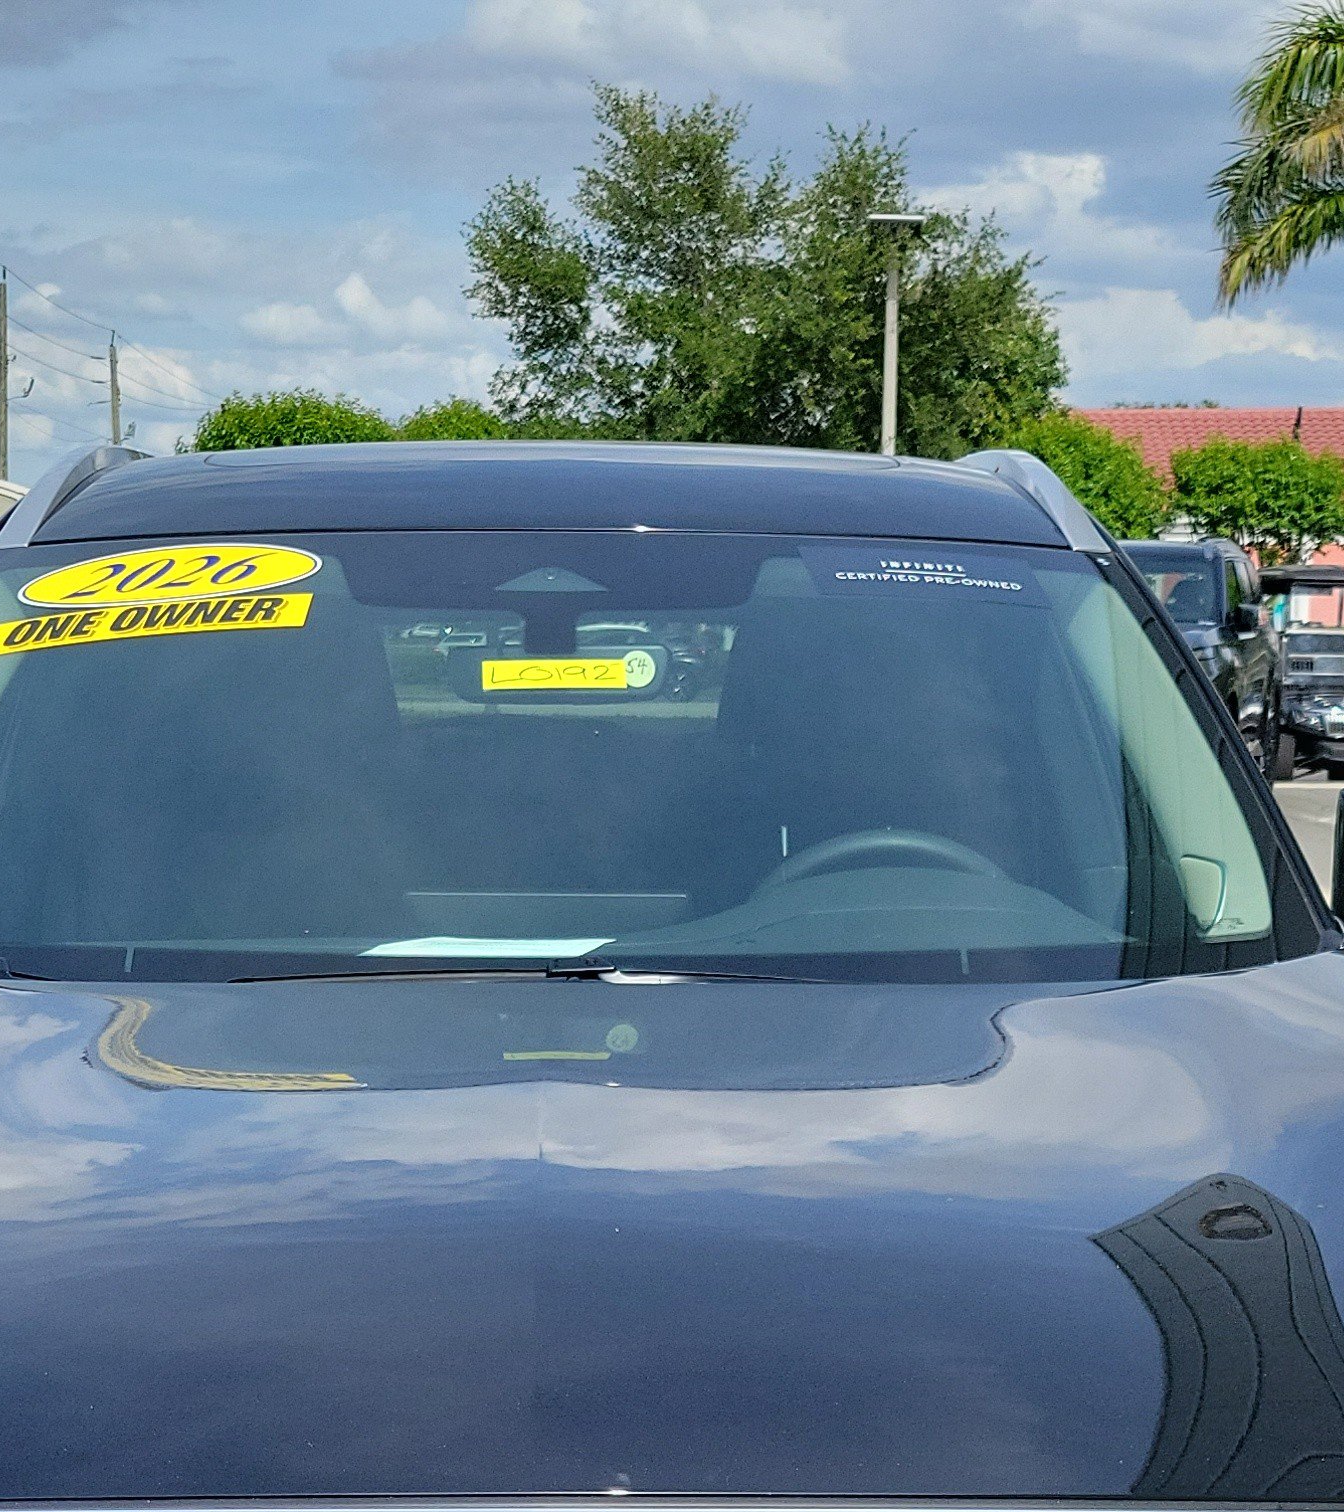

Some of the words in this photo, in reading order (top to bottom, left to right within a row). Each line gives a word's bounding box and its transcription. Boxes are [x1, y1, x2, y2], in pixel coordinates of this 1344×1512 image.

[60, 551, 279, 601] 2026
[835, 571, 920, 583] CERTIFIED
[924, 575, 1023, 591] PRE-OWNED
[2, 611, 105, 648] ONE
[111, 597, 289, 632] OWNER
